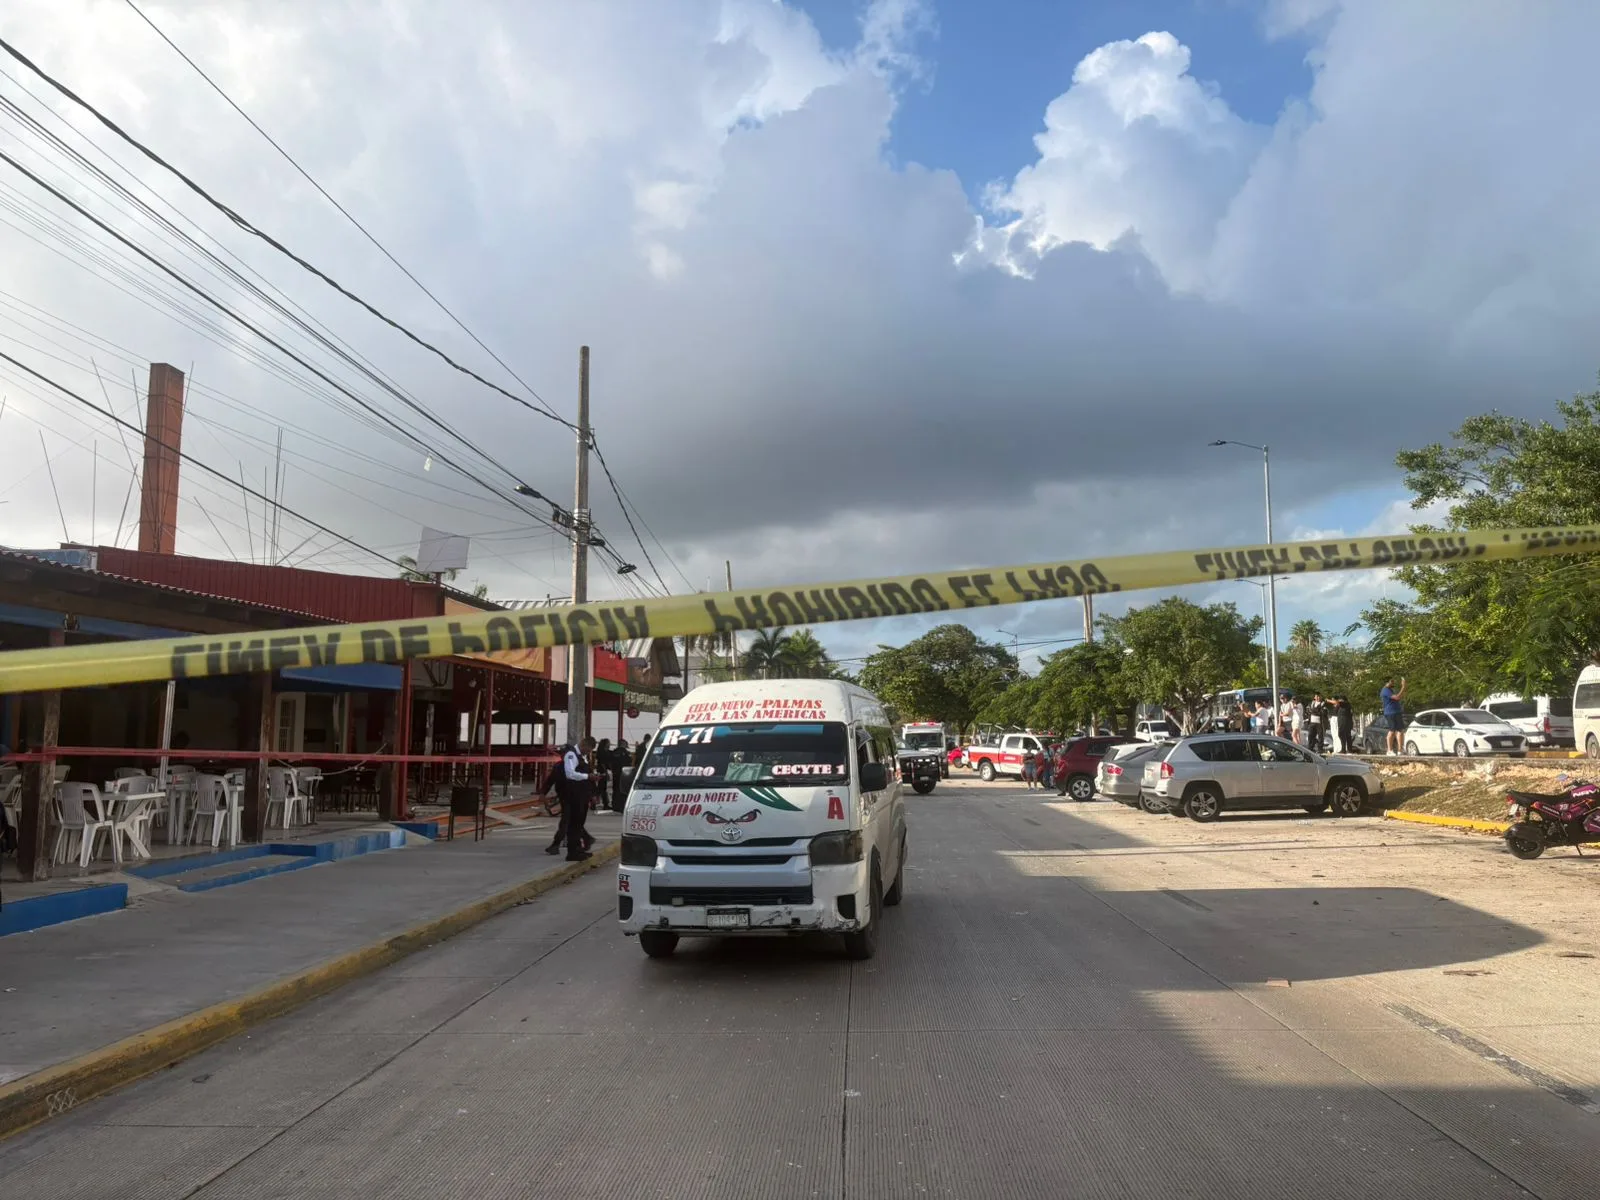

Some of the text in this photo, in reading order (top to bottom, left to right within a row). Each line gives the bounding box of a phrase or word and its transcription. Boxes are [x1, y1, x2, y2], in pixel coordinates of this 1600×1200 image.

[688, 702, 718, 713] CIELO
[684, 709, 826, 722] PZA. LAS AMERICAS
[661, 726, 715, 746] R-71
[646, 766, 715, 777] CRUCERO
[771, 764, 845, 775] CECYTE 1
[664, 793, 701, 804] PRADO
[703, 791, 739, 802] NORTE
[664, 804, 702, 817] ADO
[827, 796, 845, 820] A
[631, 818, 657, 831] 586
[619, 880, 630, 892] R
